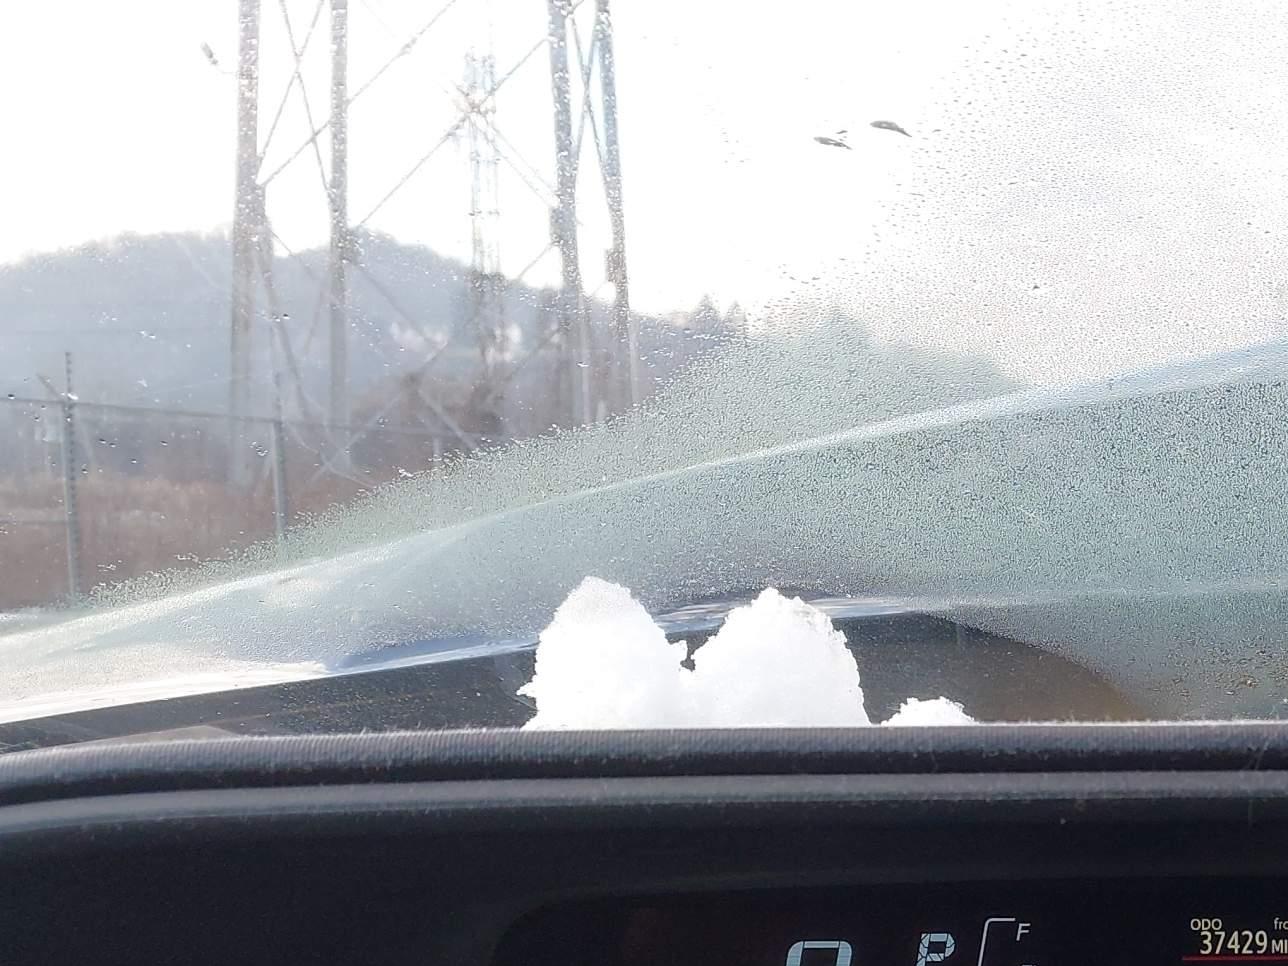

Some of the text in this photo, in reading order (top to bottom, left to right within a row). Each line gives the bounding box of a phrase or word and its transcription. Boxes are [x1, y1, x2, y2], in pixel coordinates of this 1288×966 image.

[1015, 922, 1031, 941] F
[1190, 918, 1222, 931] ODO
[1200, 931, 1268, 954] 37429
[1271, 940, 1288, 954] MI
